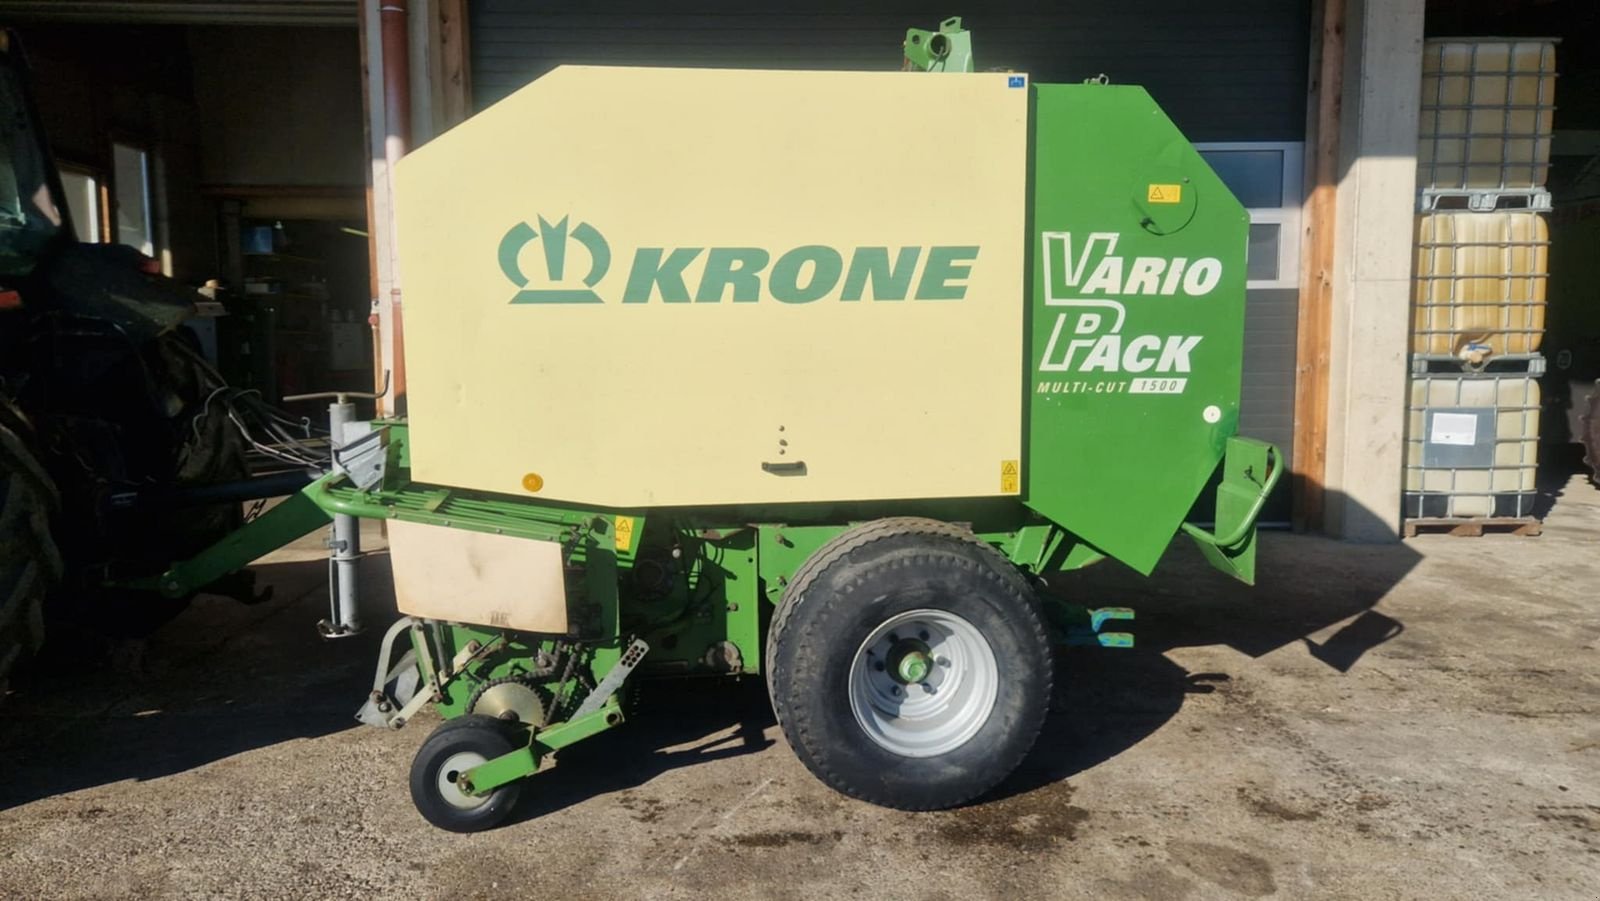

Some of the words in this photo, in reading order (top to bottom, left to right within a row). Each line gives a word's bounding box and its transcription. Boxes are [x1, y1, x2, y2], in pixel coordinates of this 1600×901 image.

[622, 245, 980, 304] KRONE
[1042, 231, 1222, 298] VARIO
[1039, 299, 1203, 372] PACK
[1037, 381, 1127, 393] MULTI-CUT
[1140, 380, 1178, 391] 1500
